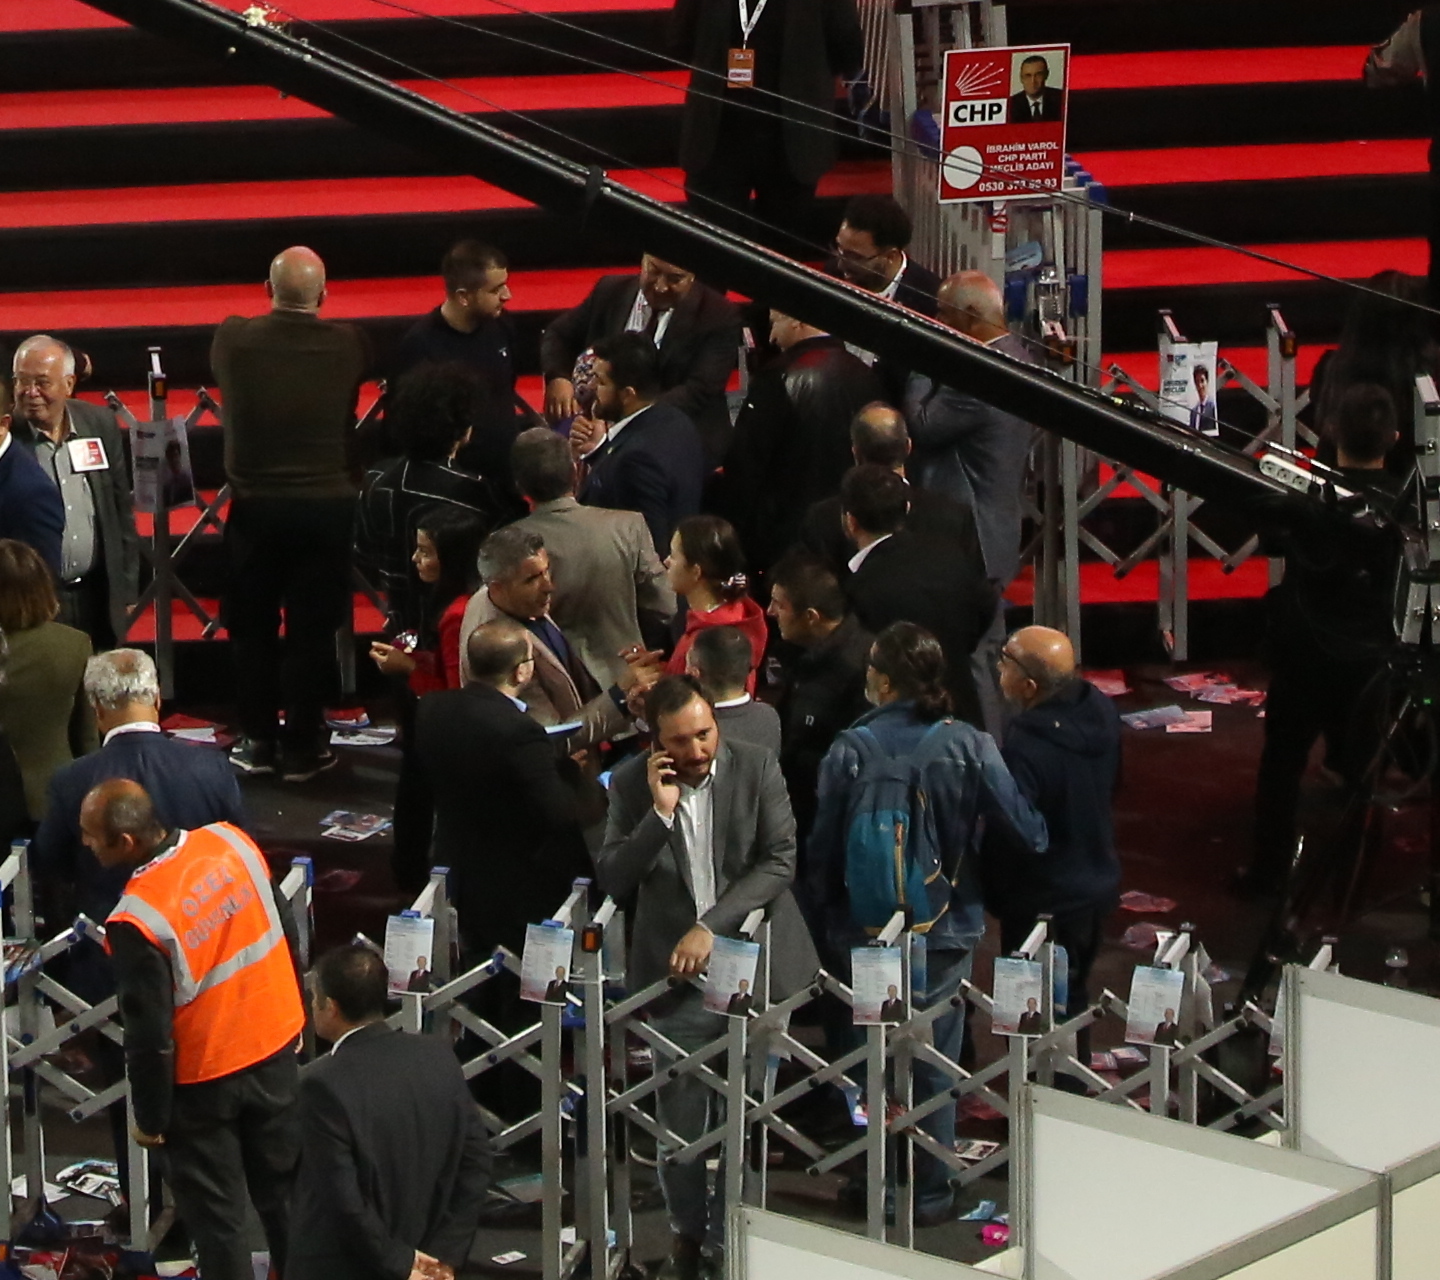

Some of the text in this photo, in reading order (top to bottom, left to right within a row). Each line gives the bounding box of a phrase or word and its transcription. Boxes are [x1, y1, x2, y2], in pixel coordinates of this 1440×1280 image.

[954, 102, 1003, 123] CHP
[987, 141, 1059, 153] İBRAHİM VAROL
[997, 150, 1047, 164] CHP PARTİ
[1025, 160, 1055, 172] ADAYI
